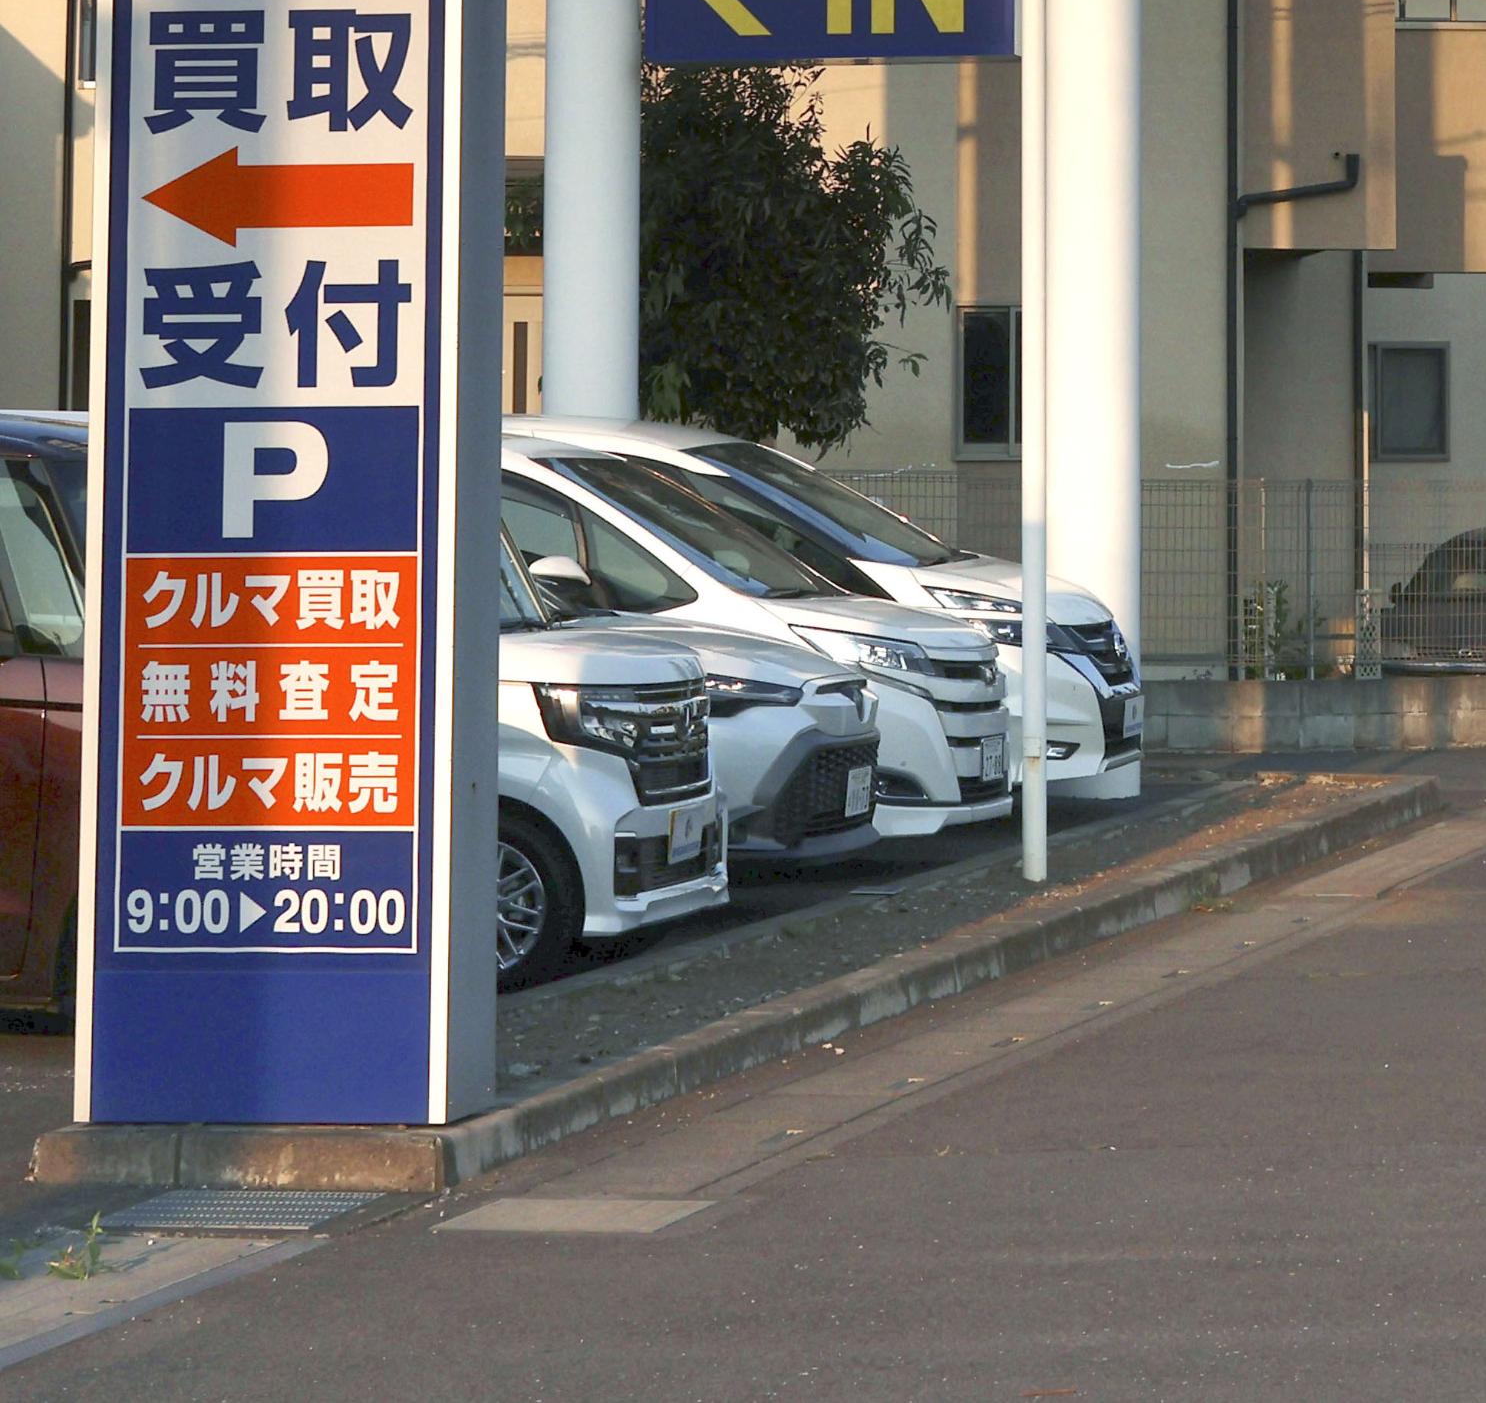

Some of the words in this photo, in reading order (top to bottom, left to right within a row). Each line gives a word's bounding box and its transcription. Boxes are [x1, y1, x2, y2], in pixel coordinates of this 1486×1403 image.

[144, 9, 413, 135] 買取
[139, 259, 412, 390] 受付
[222, 421, 329, 538] P
[143, 569, 401, 630] クルマ買取
[141, 660, 399, 722] 無料査定
[139, 751, 399, 814] クルマ販売
[193, 842, 341, 881] 営業時間
[127, 889, 230, 934] 9:00
[273, 888, 405, 934] 20:00
